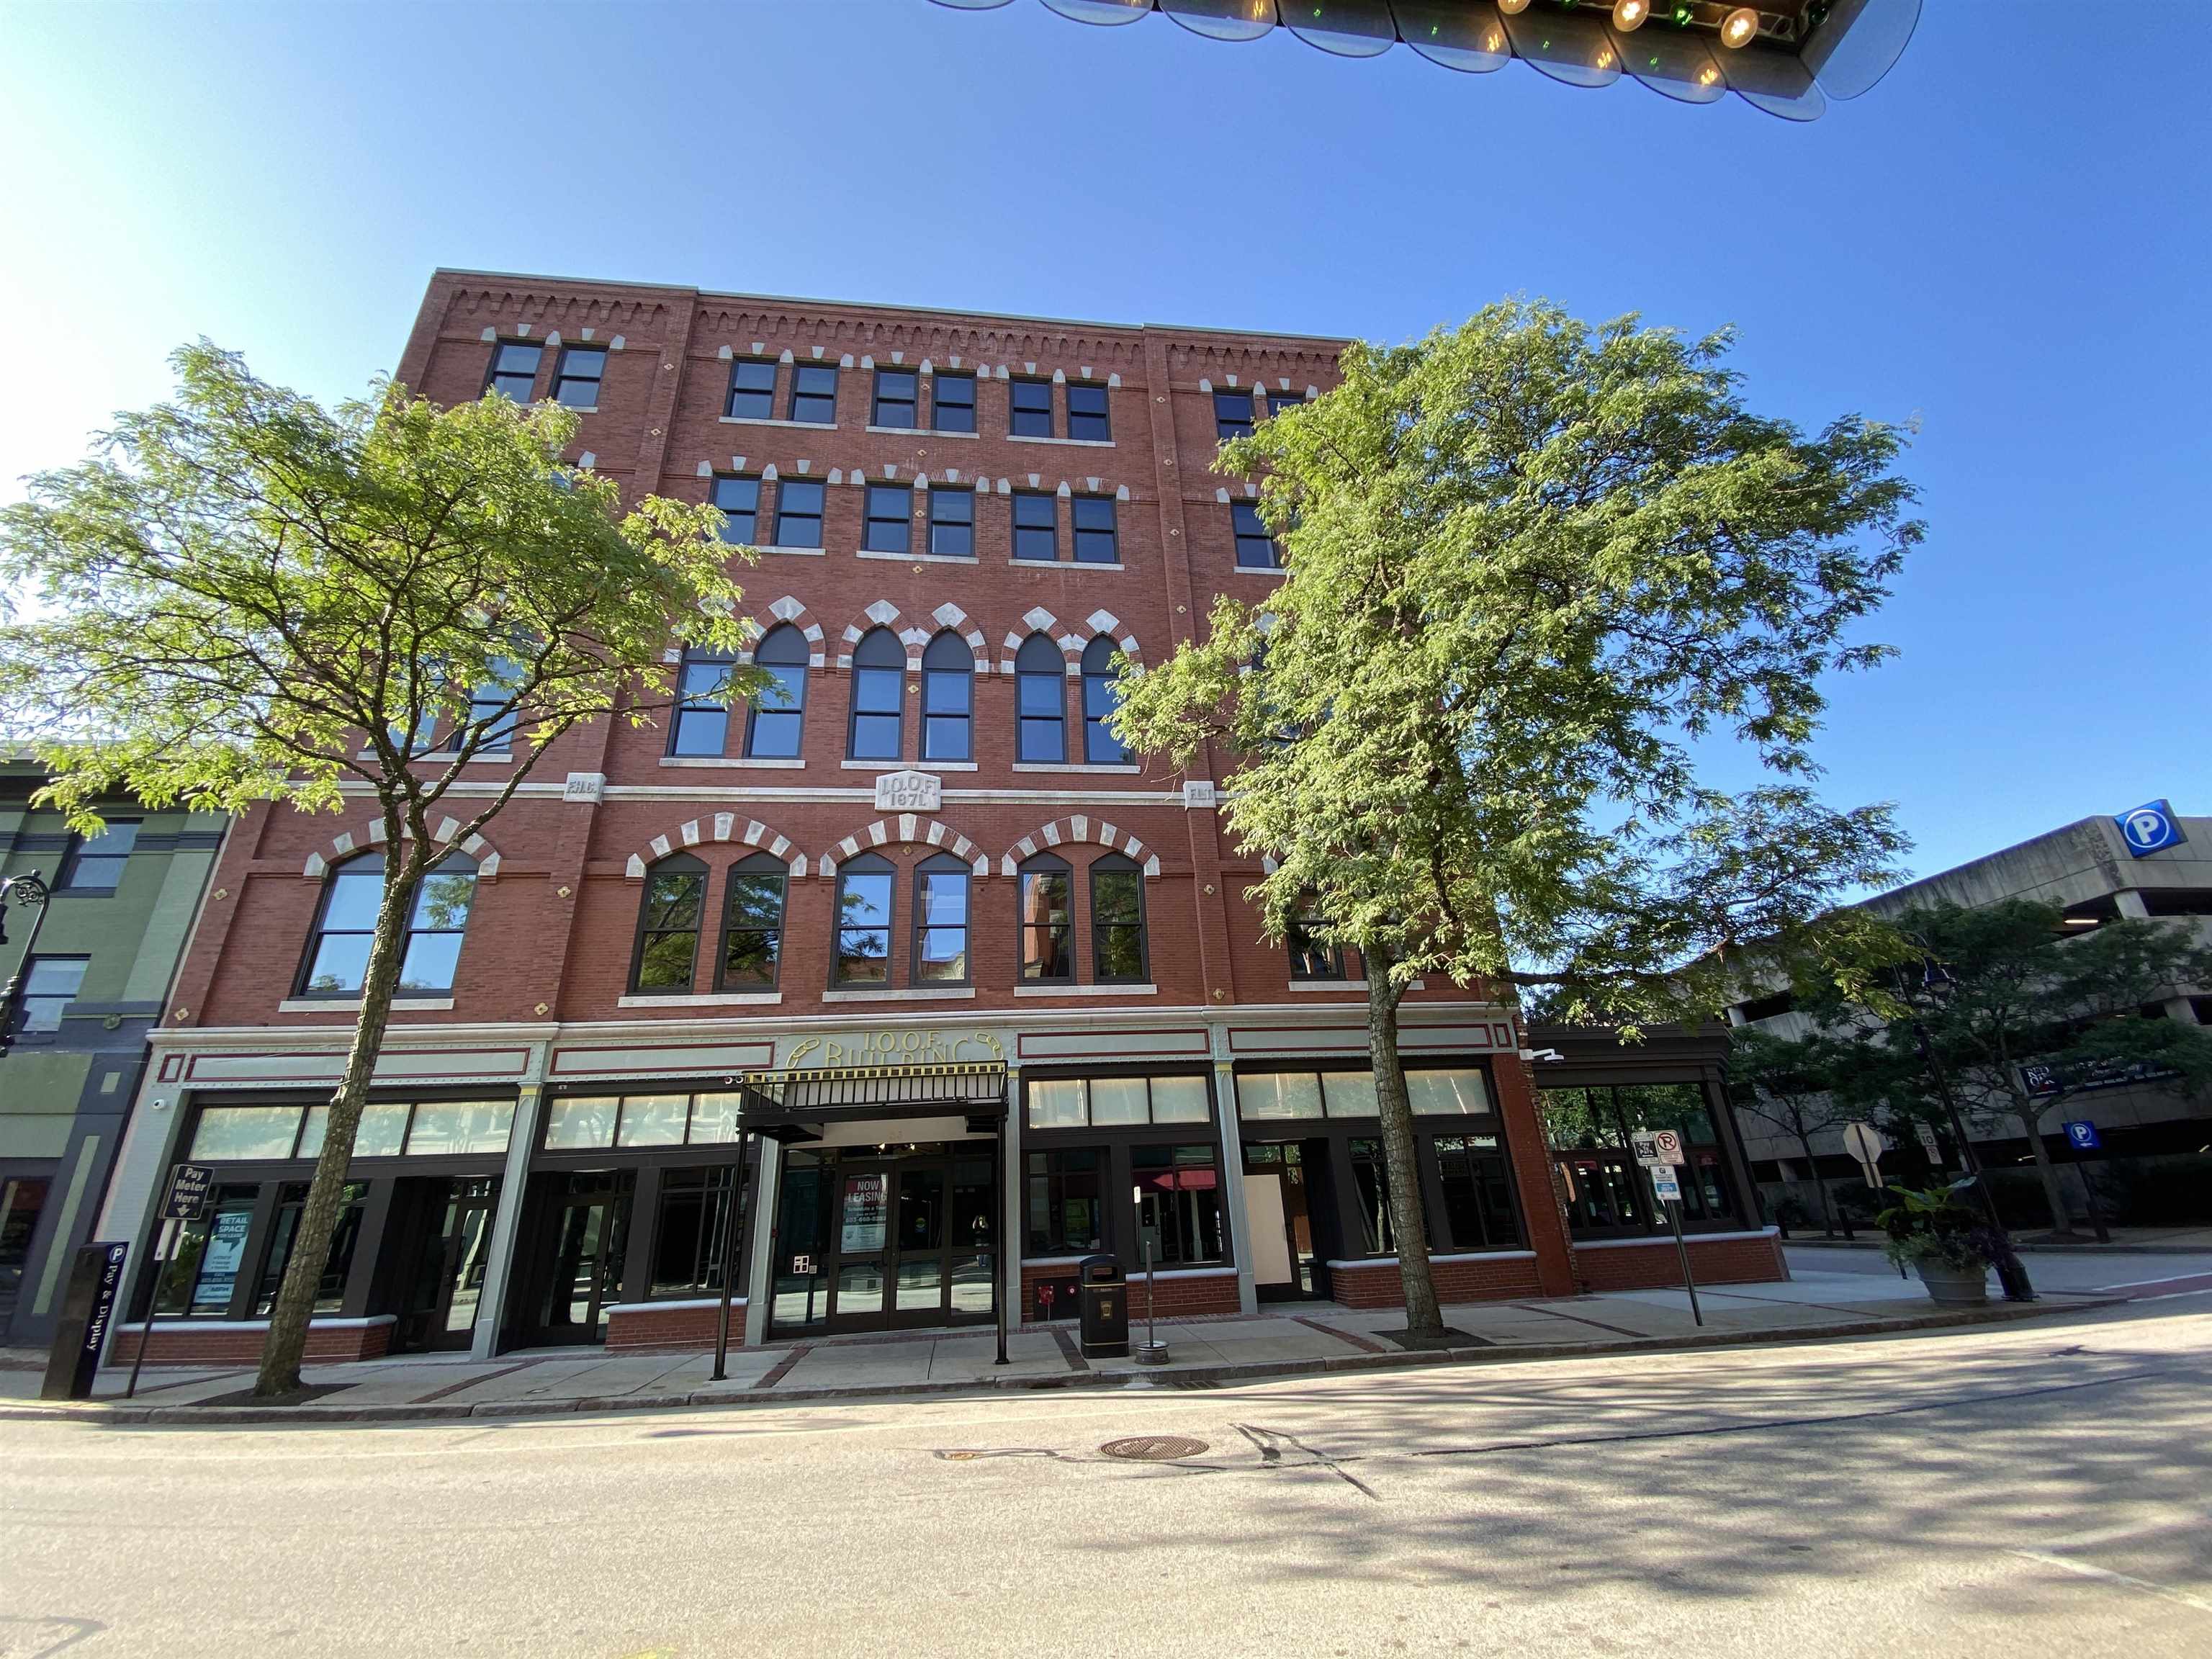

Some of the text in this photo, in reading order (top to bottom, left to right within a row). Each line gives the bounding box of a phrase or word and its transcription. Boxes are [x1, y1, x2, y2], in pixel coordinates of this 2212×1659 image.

[2131, 814, 2159, 845] P
[2074, 1126, 2087, 1139] P
[184, 1167, 204, 1181] Pay
[175, 1179, 207, 1192] Meter
[857, 1180, 879, 1192] NOW
[174, 1192, 199, 1204] Here
[848, 1192, 887, 1202] LEASING
[218, 1225, 246, 1233] SPACE
[112, 1247, 123, 1261] P
[86, 1265, 118, 1351] Pay & Display
